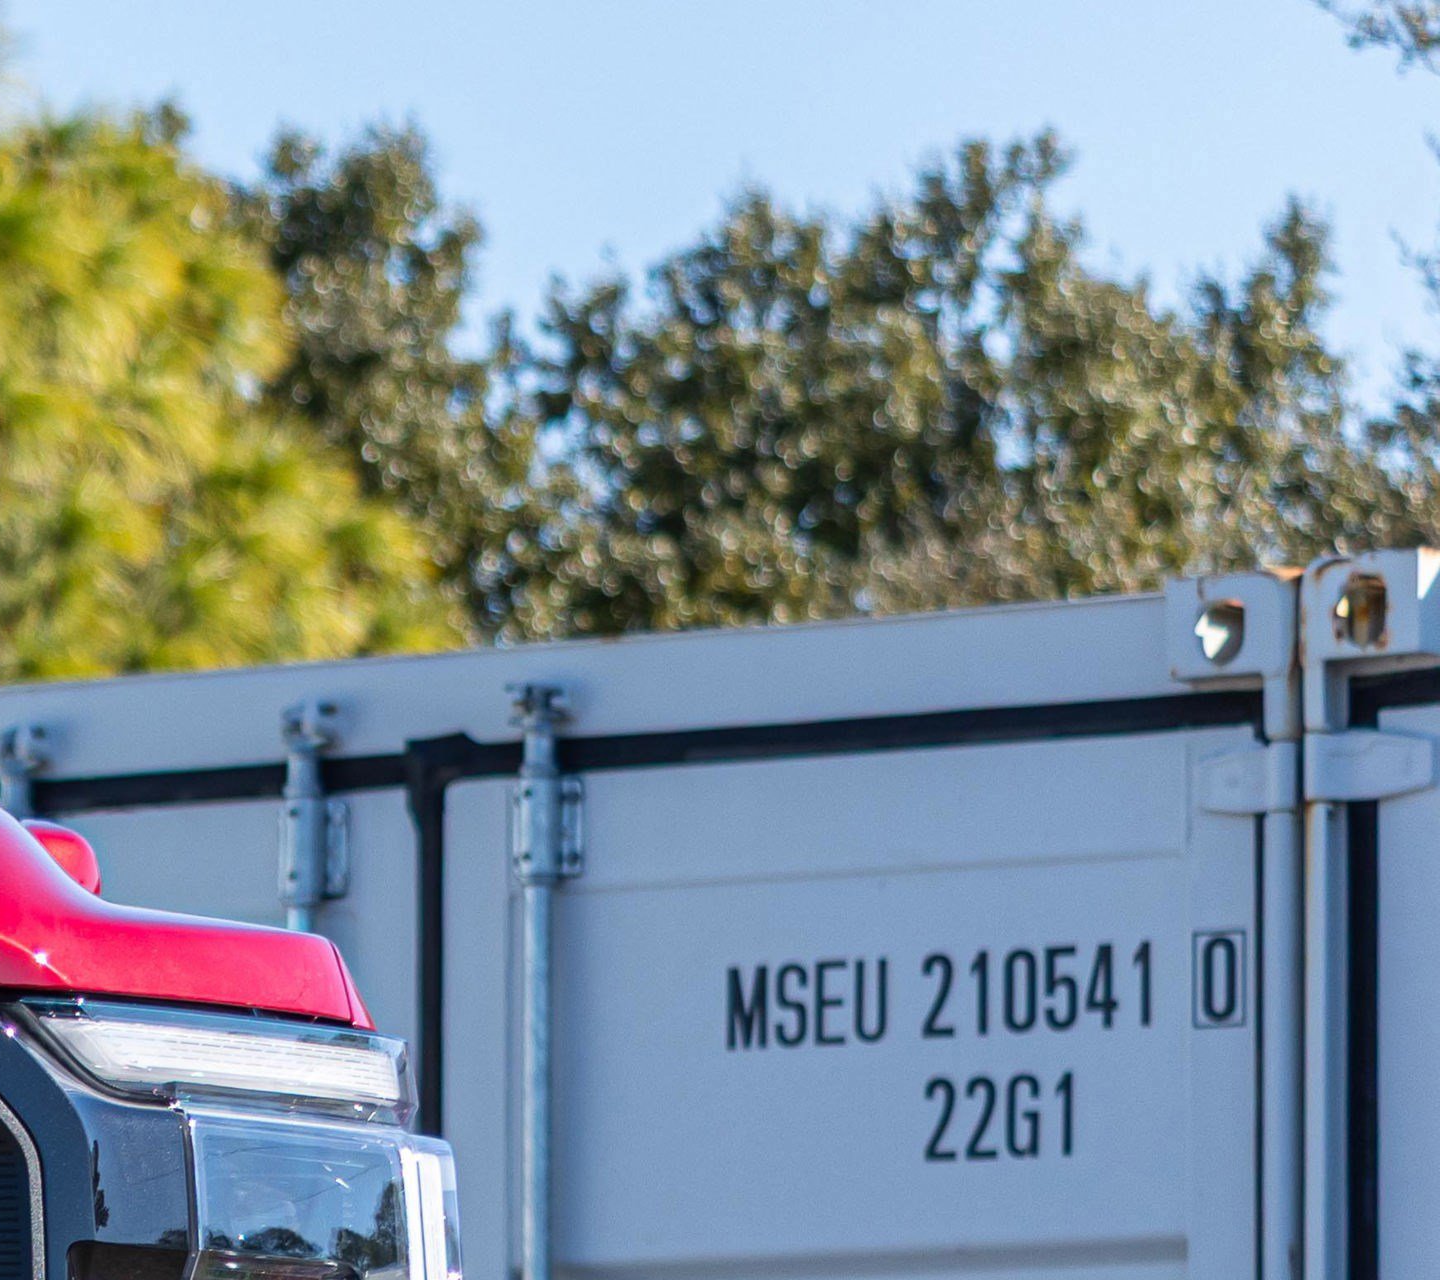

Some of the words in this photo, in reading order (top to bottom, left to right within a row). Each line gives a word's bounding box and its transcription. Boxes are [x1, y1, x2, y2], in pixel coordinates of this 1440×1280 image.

[725, 957, 889, 1051] MSEU
[920, 940, 1153, 1040] 210541
[923, 1070, 1075, 1163] 22G1
